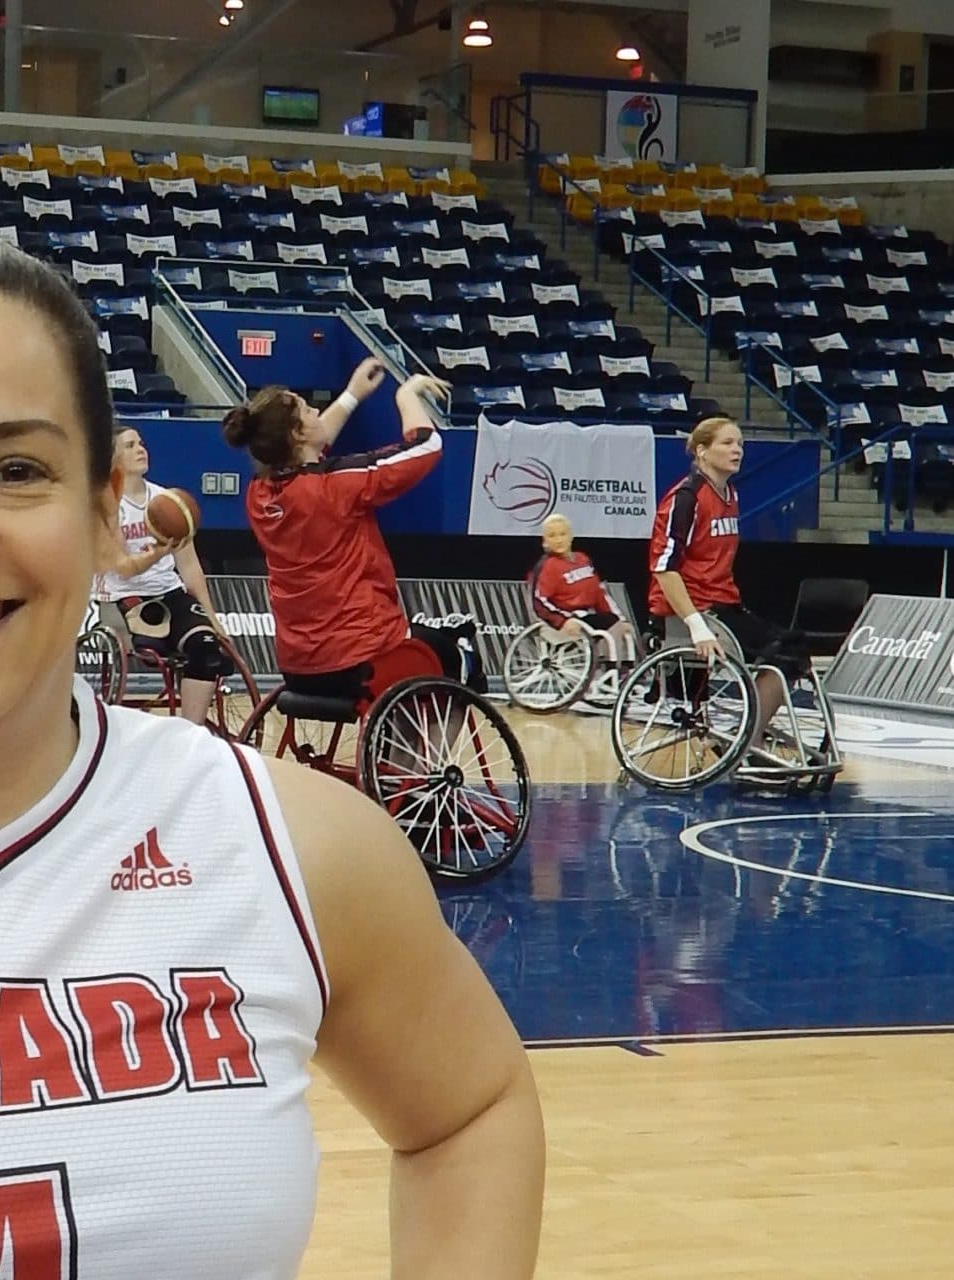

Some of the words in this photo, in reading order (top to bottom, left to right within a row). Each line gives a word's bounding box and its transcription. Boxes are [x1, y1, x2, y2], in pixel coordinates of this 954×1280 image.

[245, 339, 268, 353] EXIT
[560, 478, 647, 494] BASKETBALL
[604, 505, 647, 516] CANADA
[847, 625, 935, 660] Canada
[110, 867, 193, 891] adidas
